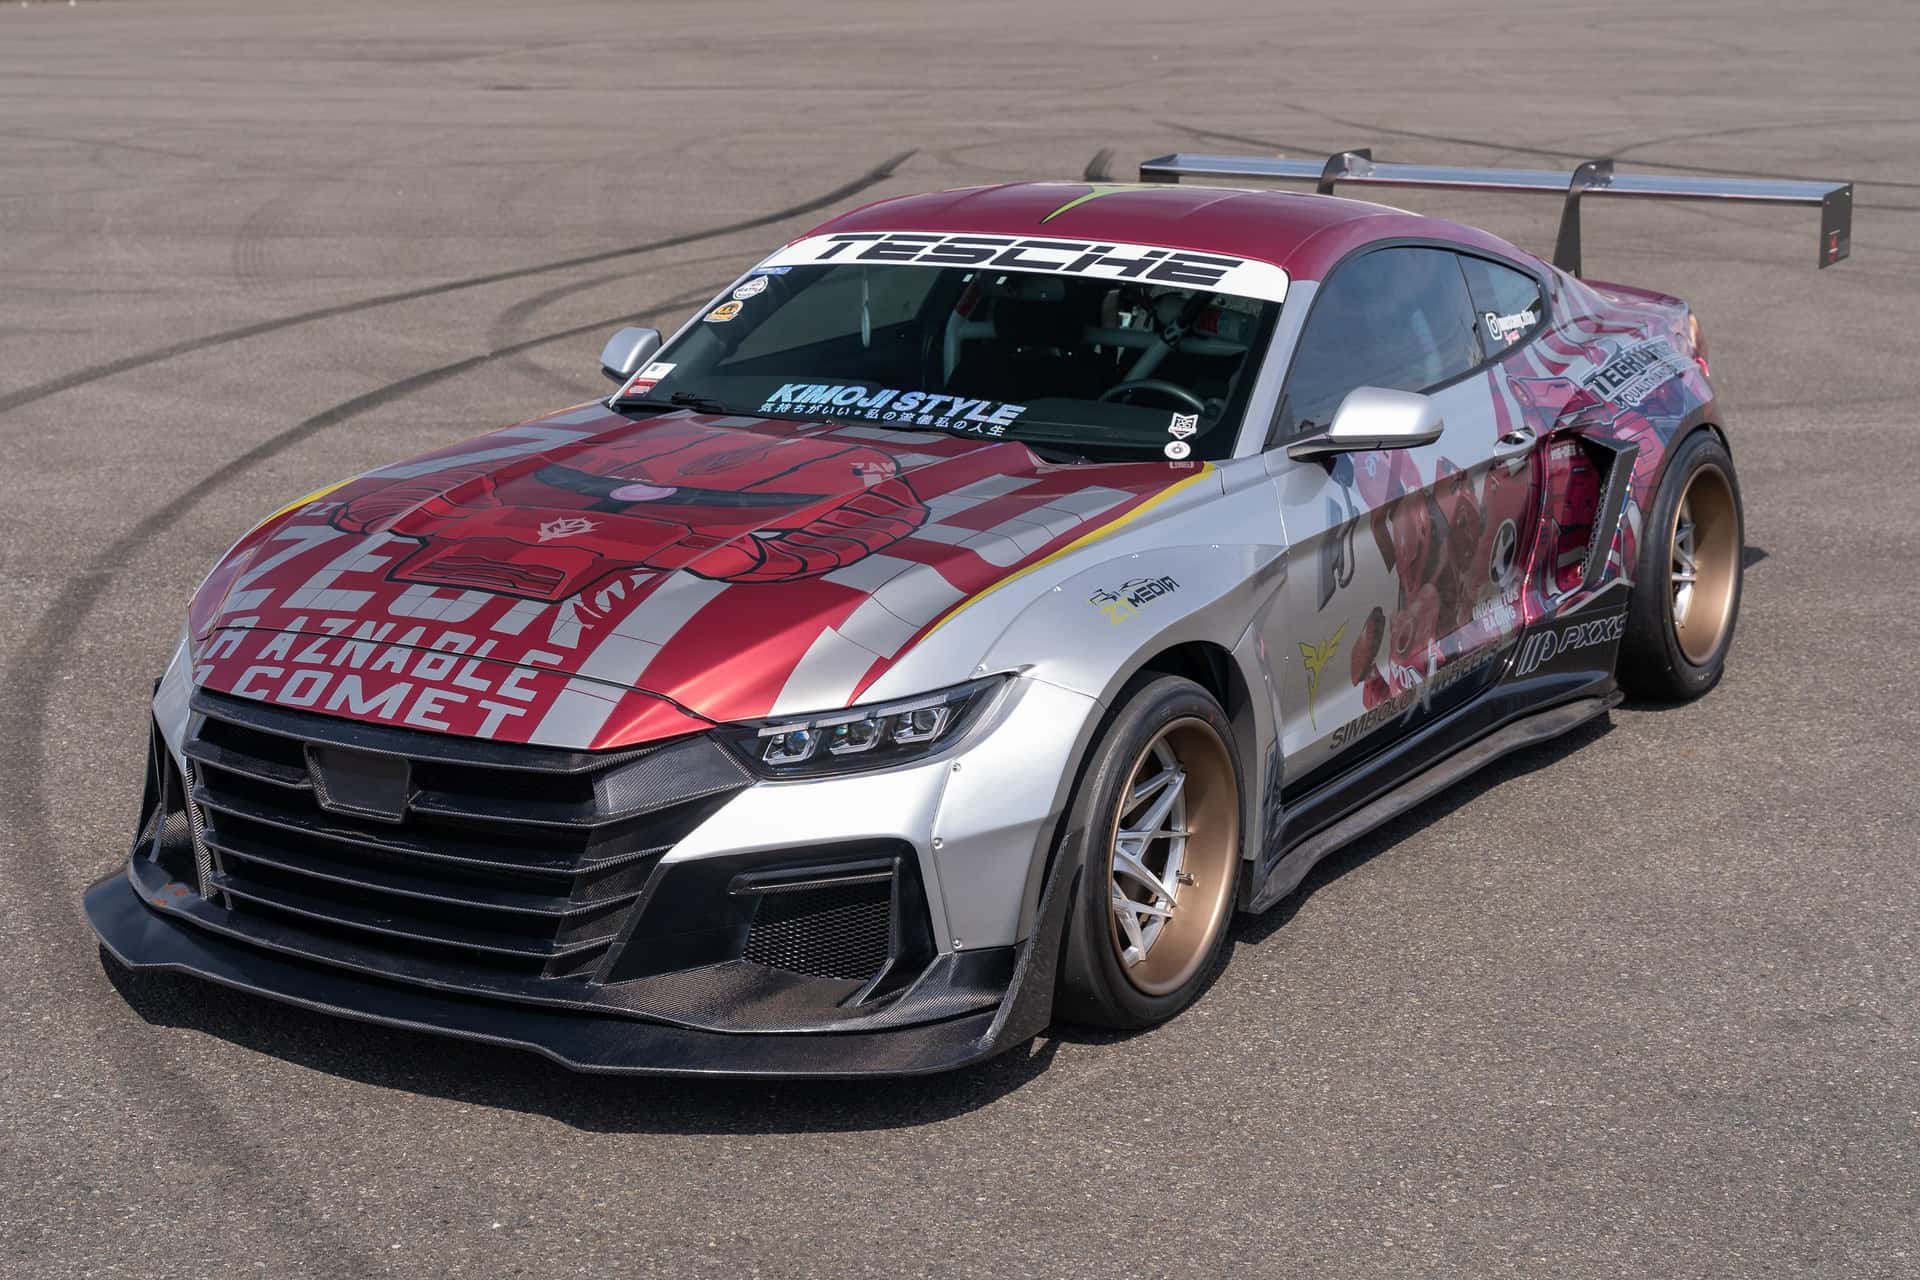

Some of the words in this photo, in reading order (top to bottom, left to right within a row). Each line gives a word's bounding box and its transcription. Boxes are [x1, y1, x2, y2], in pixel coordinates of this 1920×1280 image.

[815, 234, 1245, 286] TESCHE
[766, 383, 901, 411] KIMOJI
[891, 391, 1027, 426] STYLE
[256, 617, 567, 702] AZNABLE
[231, 665, 528, 739] COMET
